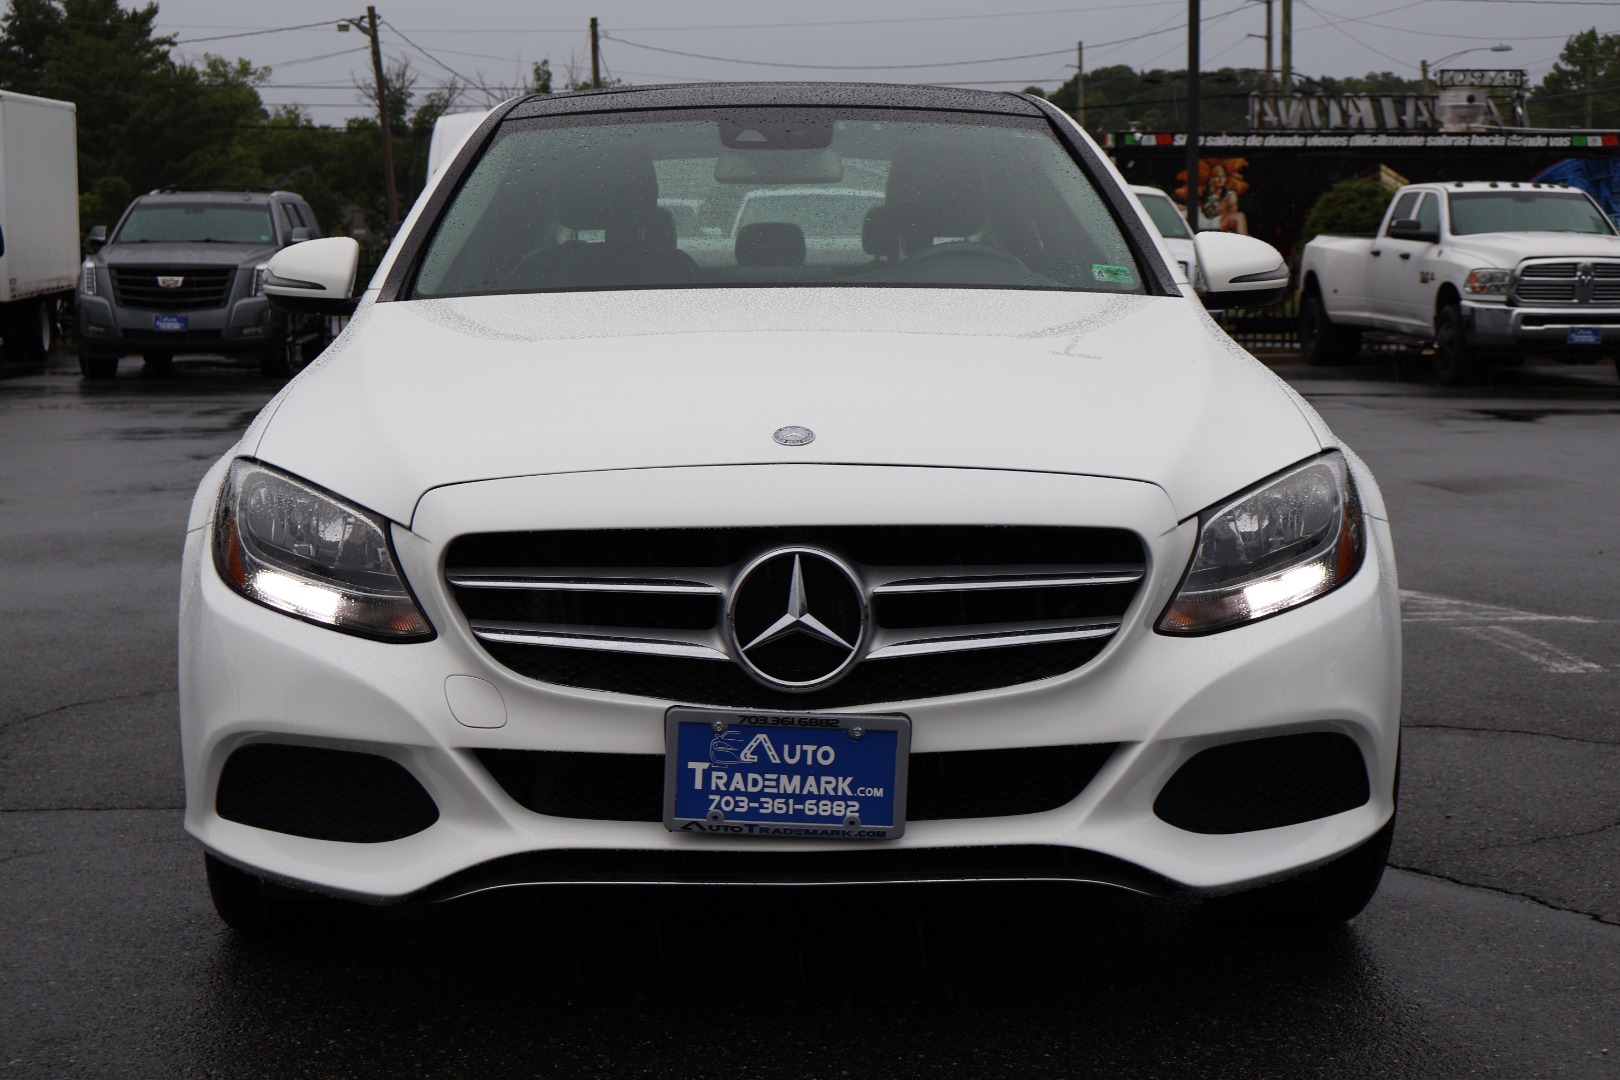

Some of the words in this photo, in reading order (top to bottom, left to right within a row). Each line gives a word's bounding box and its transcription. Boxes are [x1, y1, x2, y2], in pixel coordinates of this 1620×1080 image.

[1205, 133, 1246, 146] sabes
[1246, 134, 1264, 147] de
[1264, 134, 1306, 147] donde
[1306, 135, 1349, 147] vienes
[1425, 135, 1469, 147] sabras
[1470, 134, 1506, 147] hacia
[1549, 136, 1571, 147] vas
[739, 733, 836, 766] AUTO
[707, 794, 861, 818] 703-361-6882
